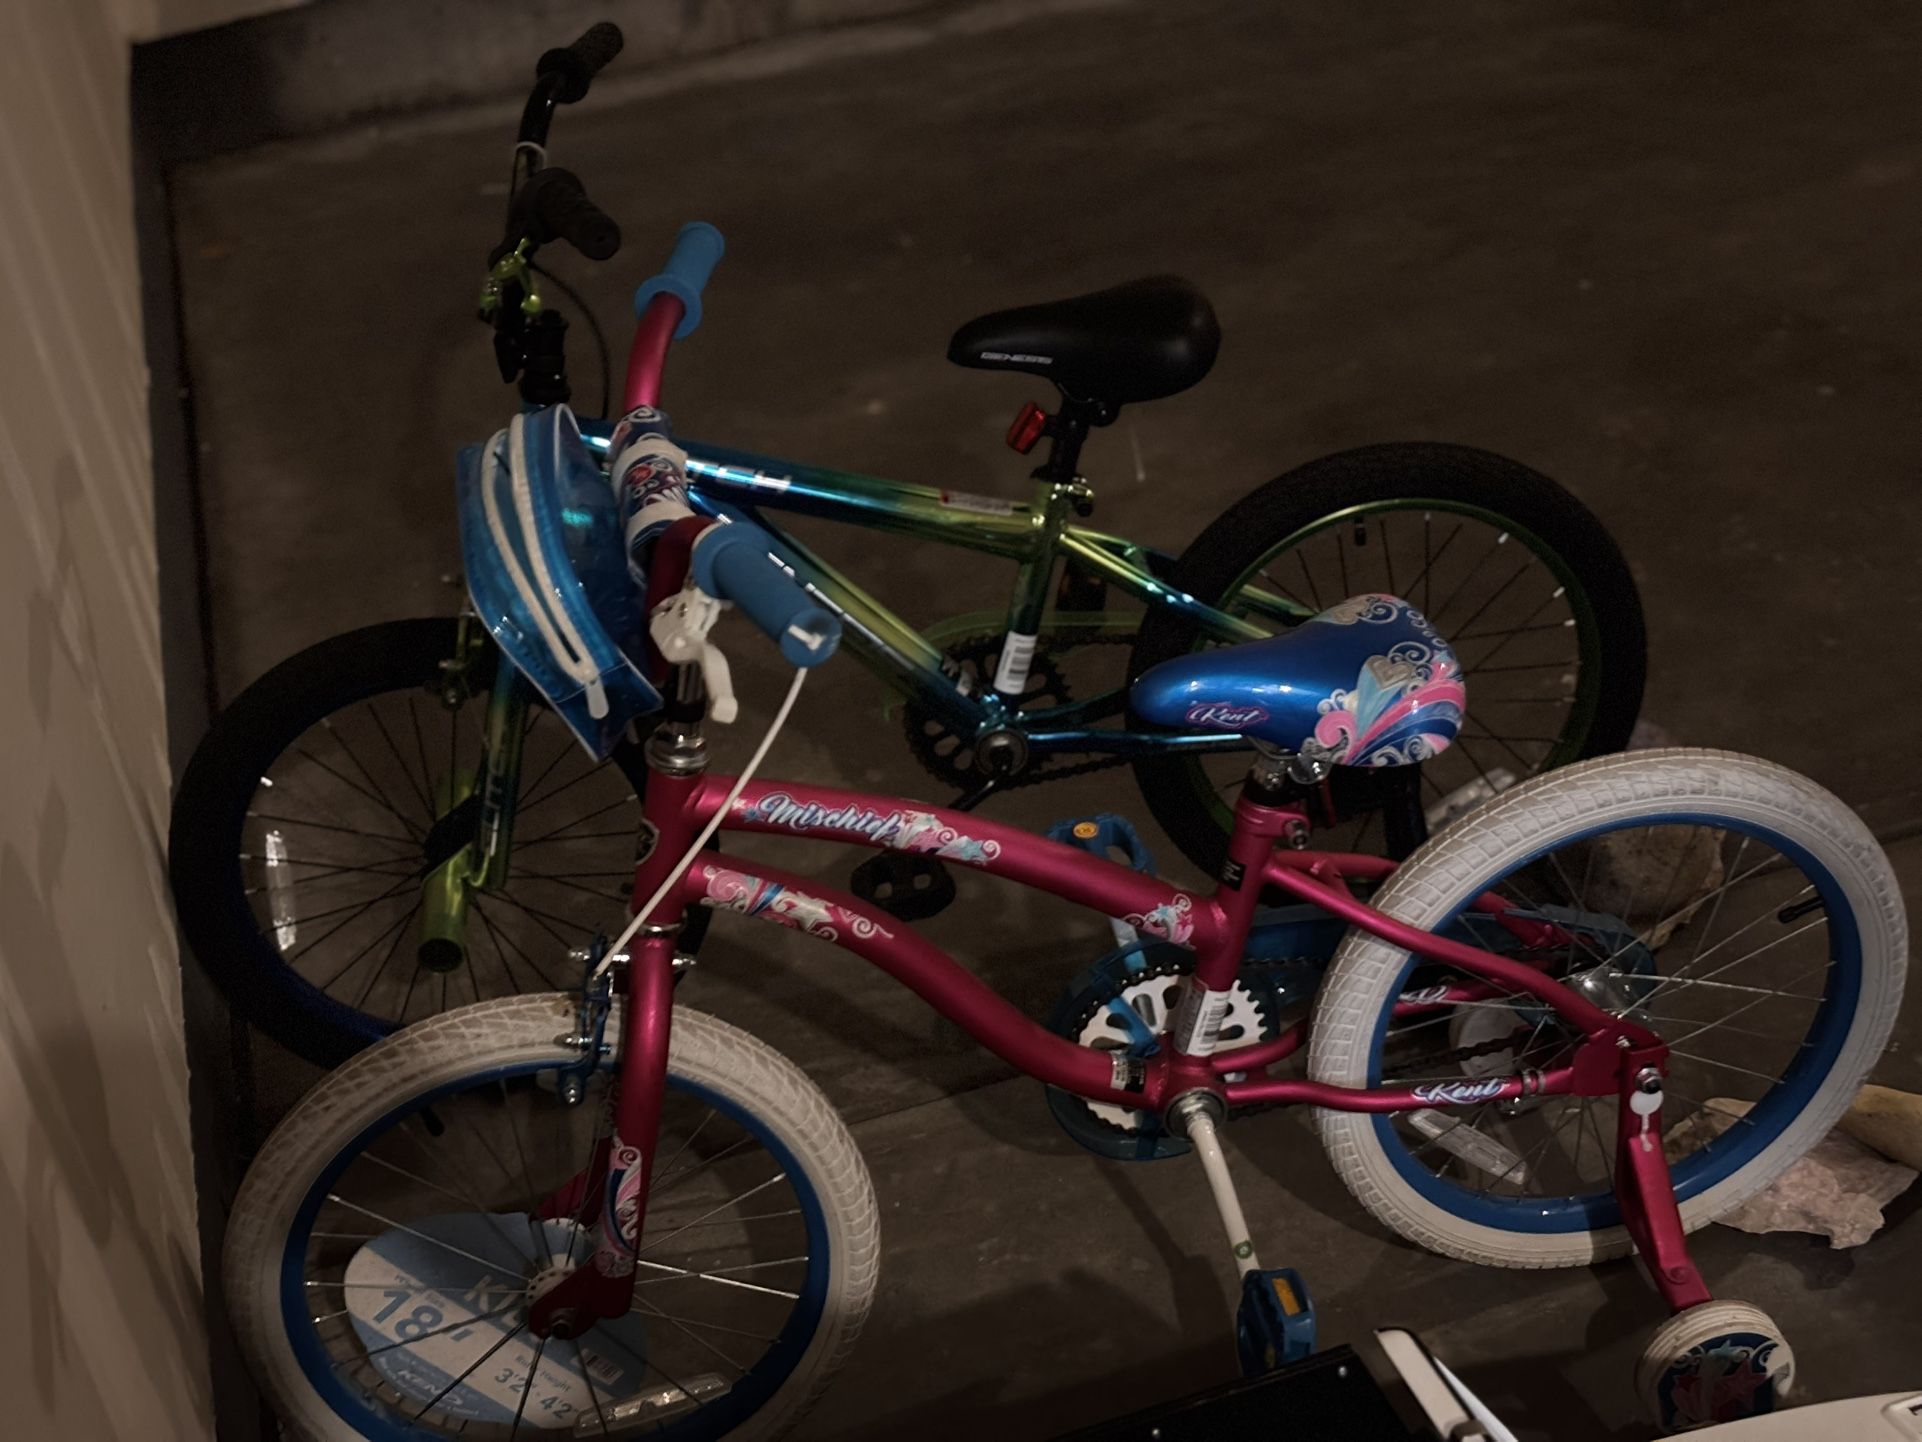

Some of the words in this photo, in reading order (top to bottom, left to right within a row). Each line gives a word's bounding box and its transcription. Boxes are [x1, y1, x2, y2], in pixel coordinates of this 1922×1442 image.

[1186, 706, 1262, 728] Kent
[757, 791, 902, 842] Mischief
[1412, 1077, 1506, 1105] Kent
